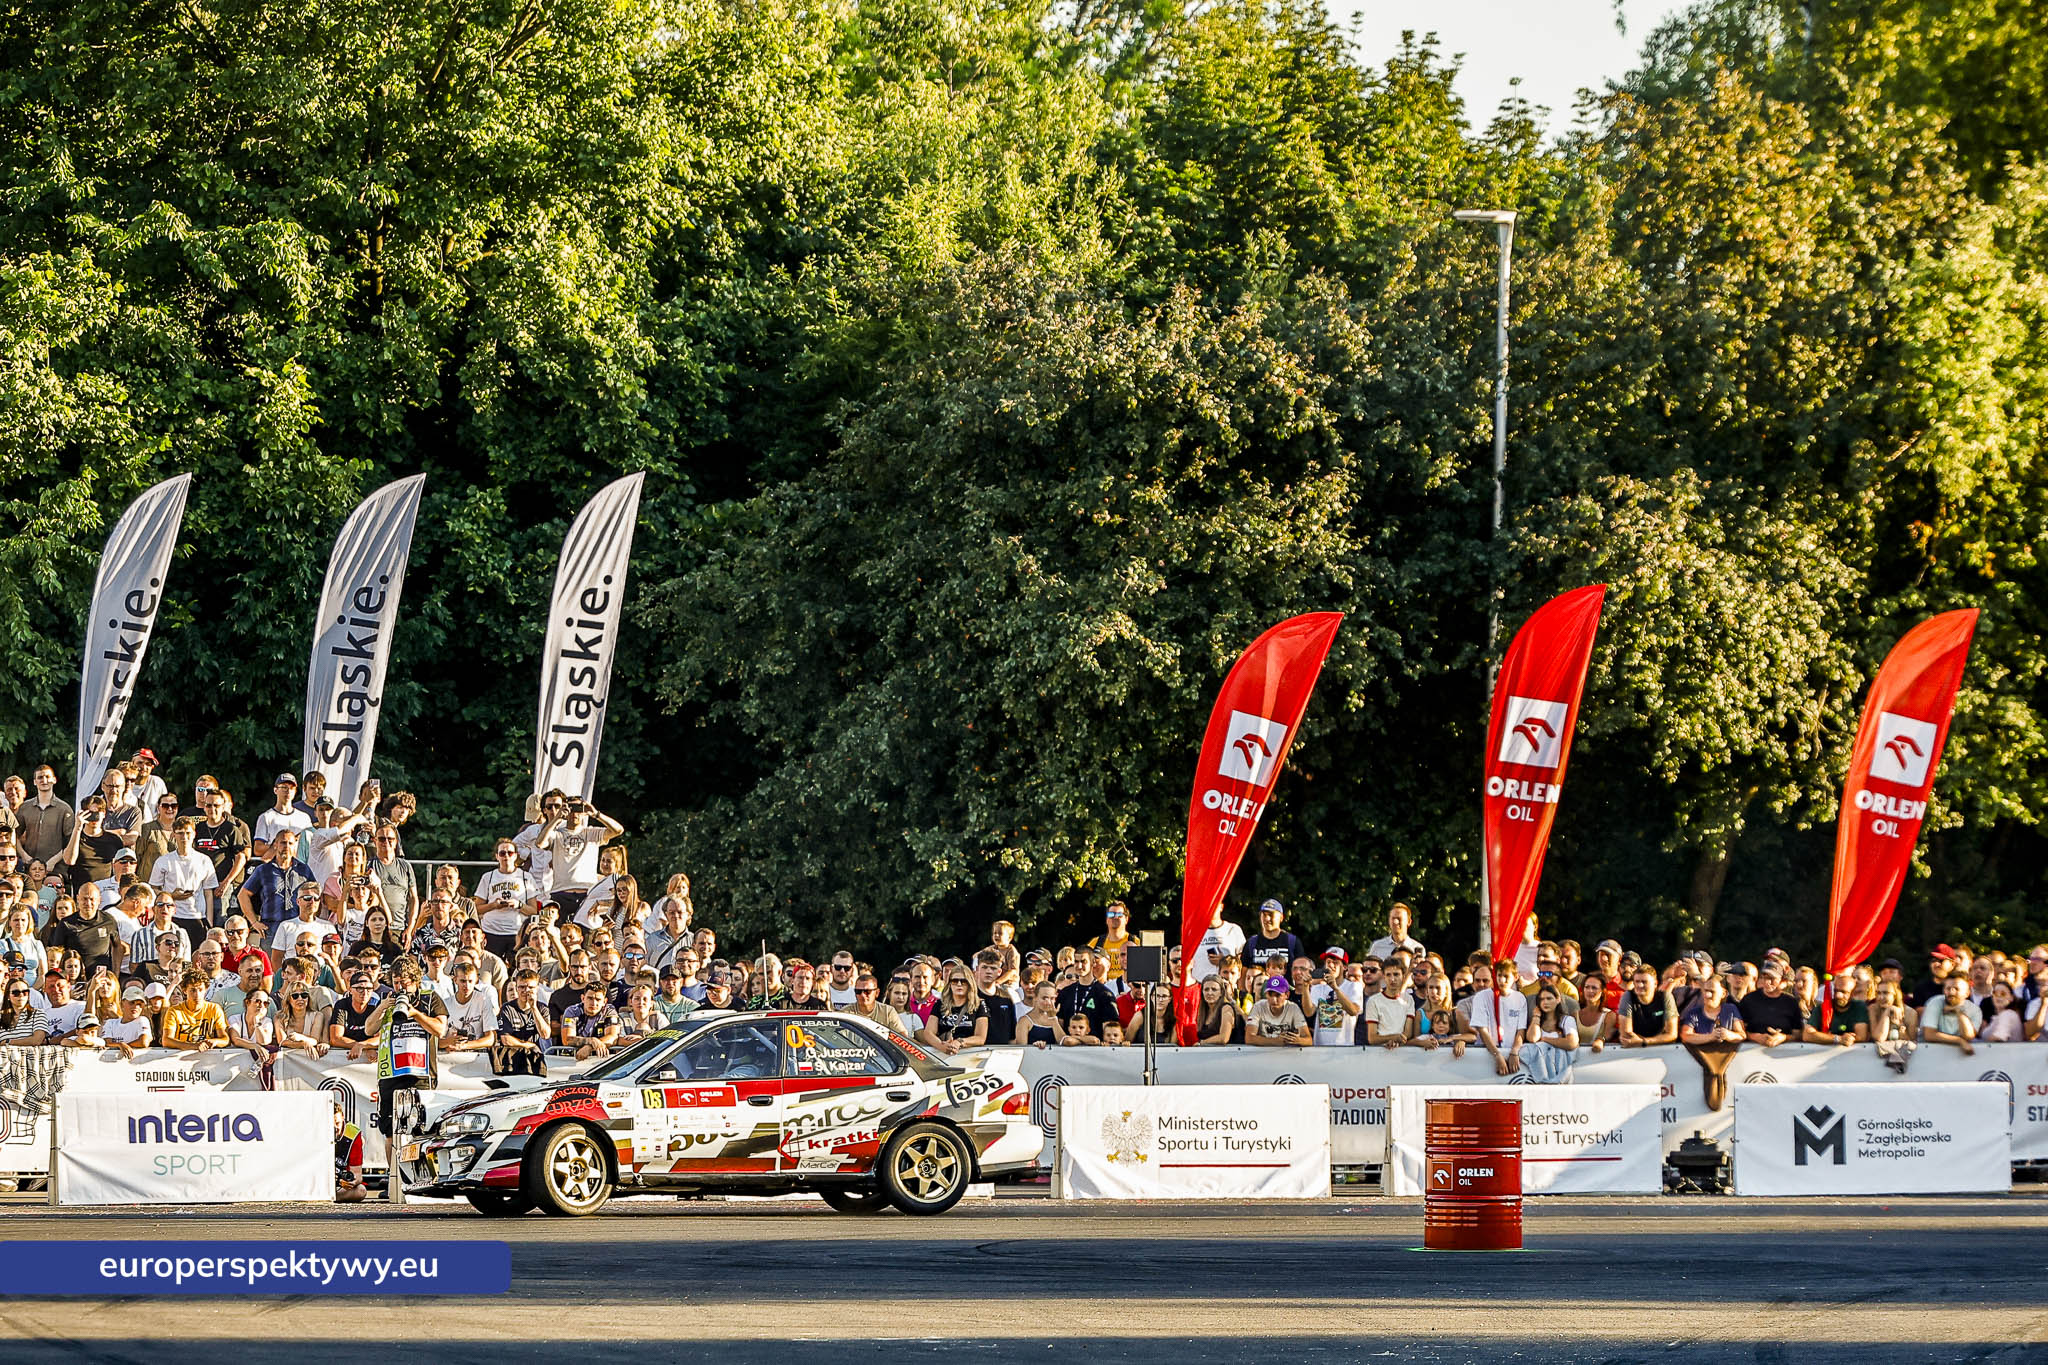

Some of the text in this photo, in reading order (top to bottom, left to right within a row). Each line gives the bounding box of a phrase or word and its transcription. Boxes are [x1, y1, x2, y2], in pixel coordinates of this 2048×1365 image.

[314, 574, 390, 767] Śląskie.
[543, 574, 613, 769] Śląskie.
[1487, 775, 1561, 804] ORLEN
[1507, 804, 1535, 822] OIL
[1855, 789, 1927, 820] ORLEN
[1218, 819, 1238, 837] OIL
[1872, 818, 1900, 838] OIL
[888, 1031, 927, 1062] SERWIS
[380, 1054, 391, 1077] POL
[829, 1060, 866, 1073] Kajzar
[135, 1069, 210, 1085] STADION ŚLĄSKI
[952, 1074, 1004, 1101] 555
[1330, 1087, 1386, 1104] upera
[1158, 1116, 1258, 1130] Ministerstwo
[1330, 1108, 1386, 1125] TADION
[1522, 1111, 1589, 1125] sterstwo
[1858, 1118, 1933, 1131] Górnośląsko
[128, 1109, 264, 1144] interia
[1158, 1136, 1209, 1153] Sportu
[1222, 1136, 1292, 1153] Turystyki
[1555, 1130, 1623, 1148] Turystyki
[1858, 1146, 1926, 1161] Metropolia
[153, 1153, 242, 1176] SPORT
[799, 1160, 838, 1169] MarCar
[1458, 1168, 1494, 1177] ORLEN
[1458, 1178, 1473, 1186] OIL
